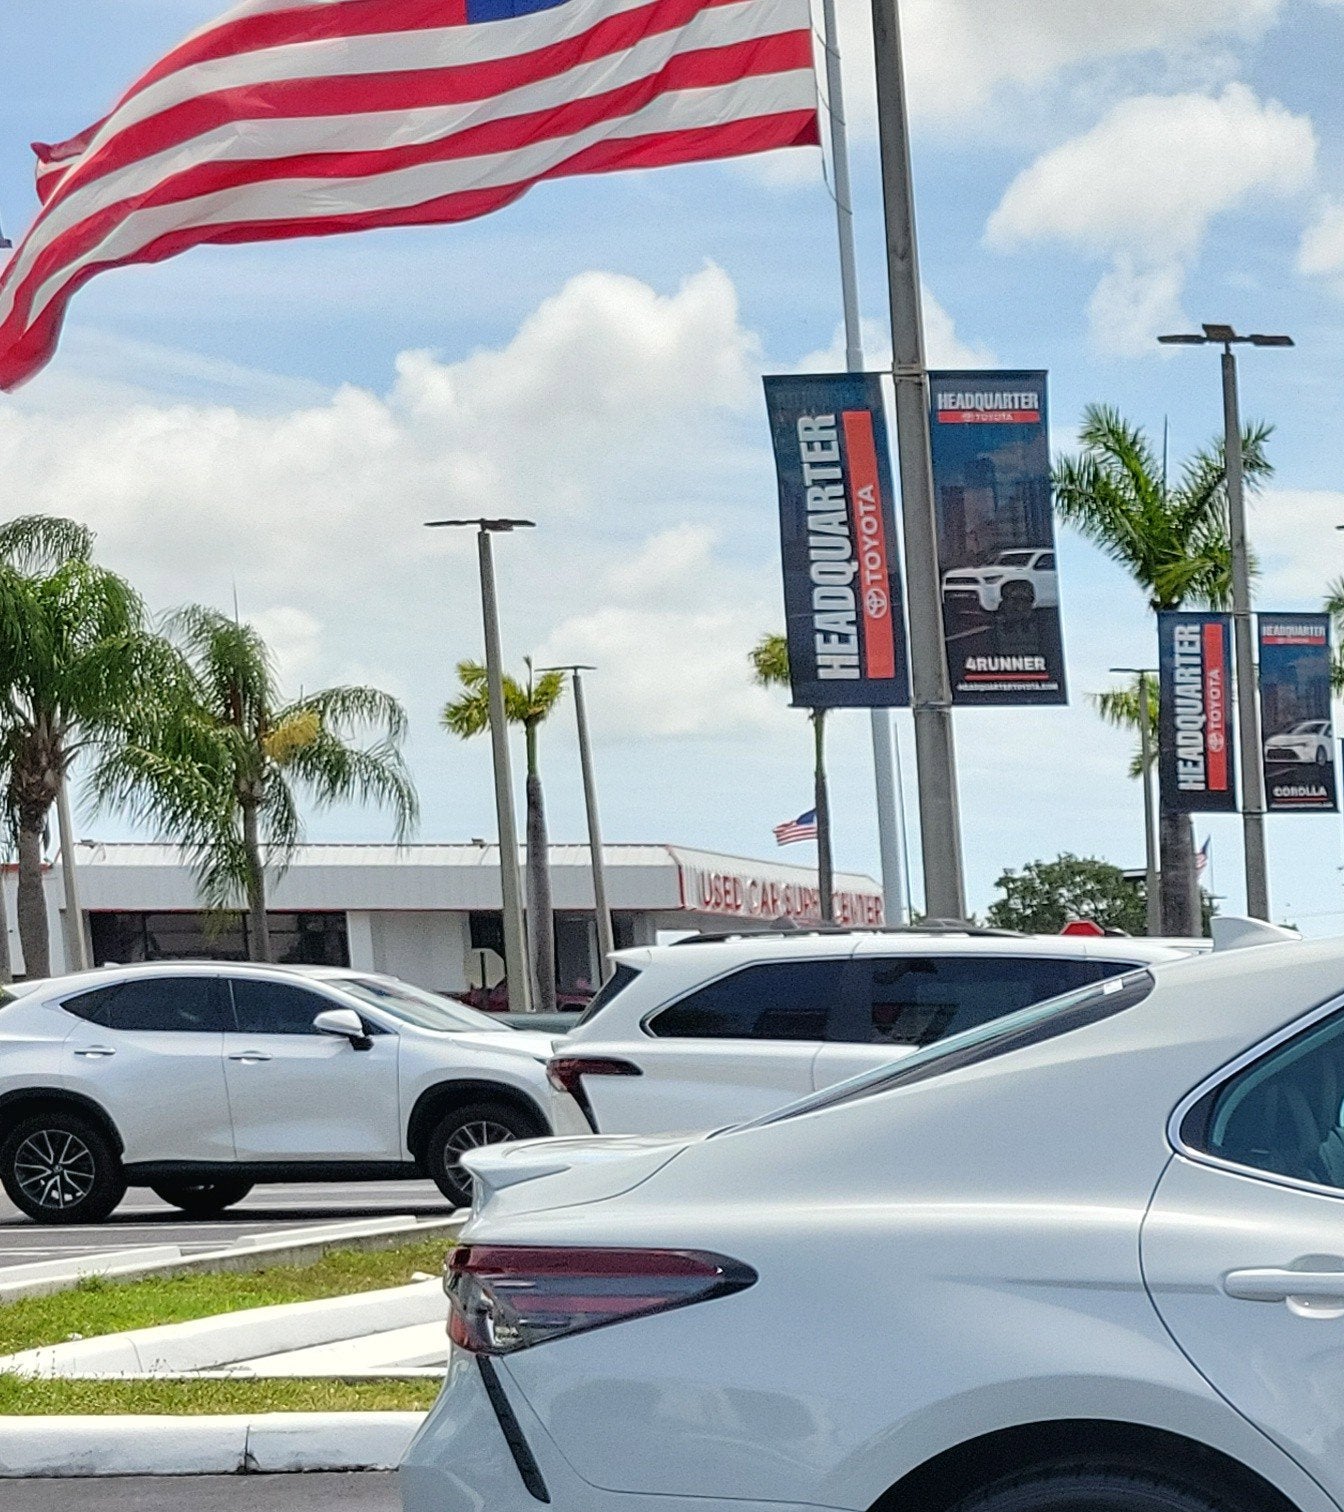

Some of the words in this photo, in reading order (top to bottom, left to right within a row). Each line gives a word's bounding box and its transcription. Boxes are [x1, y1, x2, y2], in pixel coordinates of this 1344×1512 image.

[937, 392, 1039, 412] HEADQUARTER
[798, 413, 860, 680] HEADQUARTER
[856, 485, 883, 585] TOYOTA
[965, 656, 1047, 671] 4RUNNER
[1174, 623, 1207, 791] HEADQUARTER
[1208, 668, 1222, 731] TOYOTA
[1272, 786, 1328, 797] COROLLA
[700, 871, 744, 911] USED
